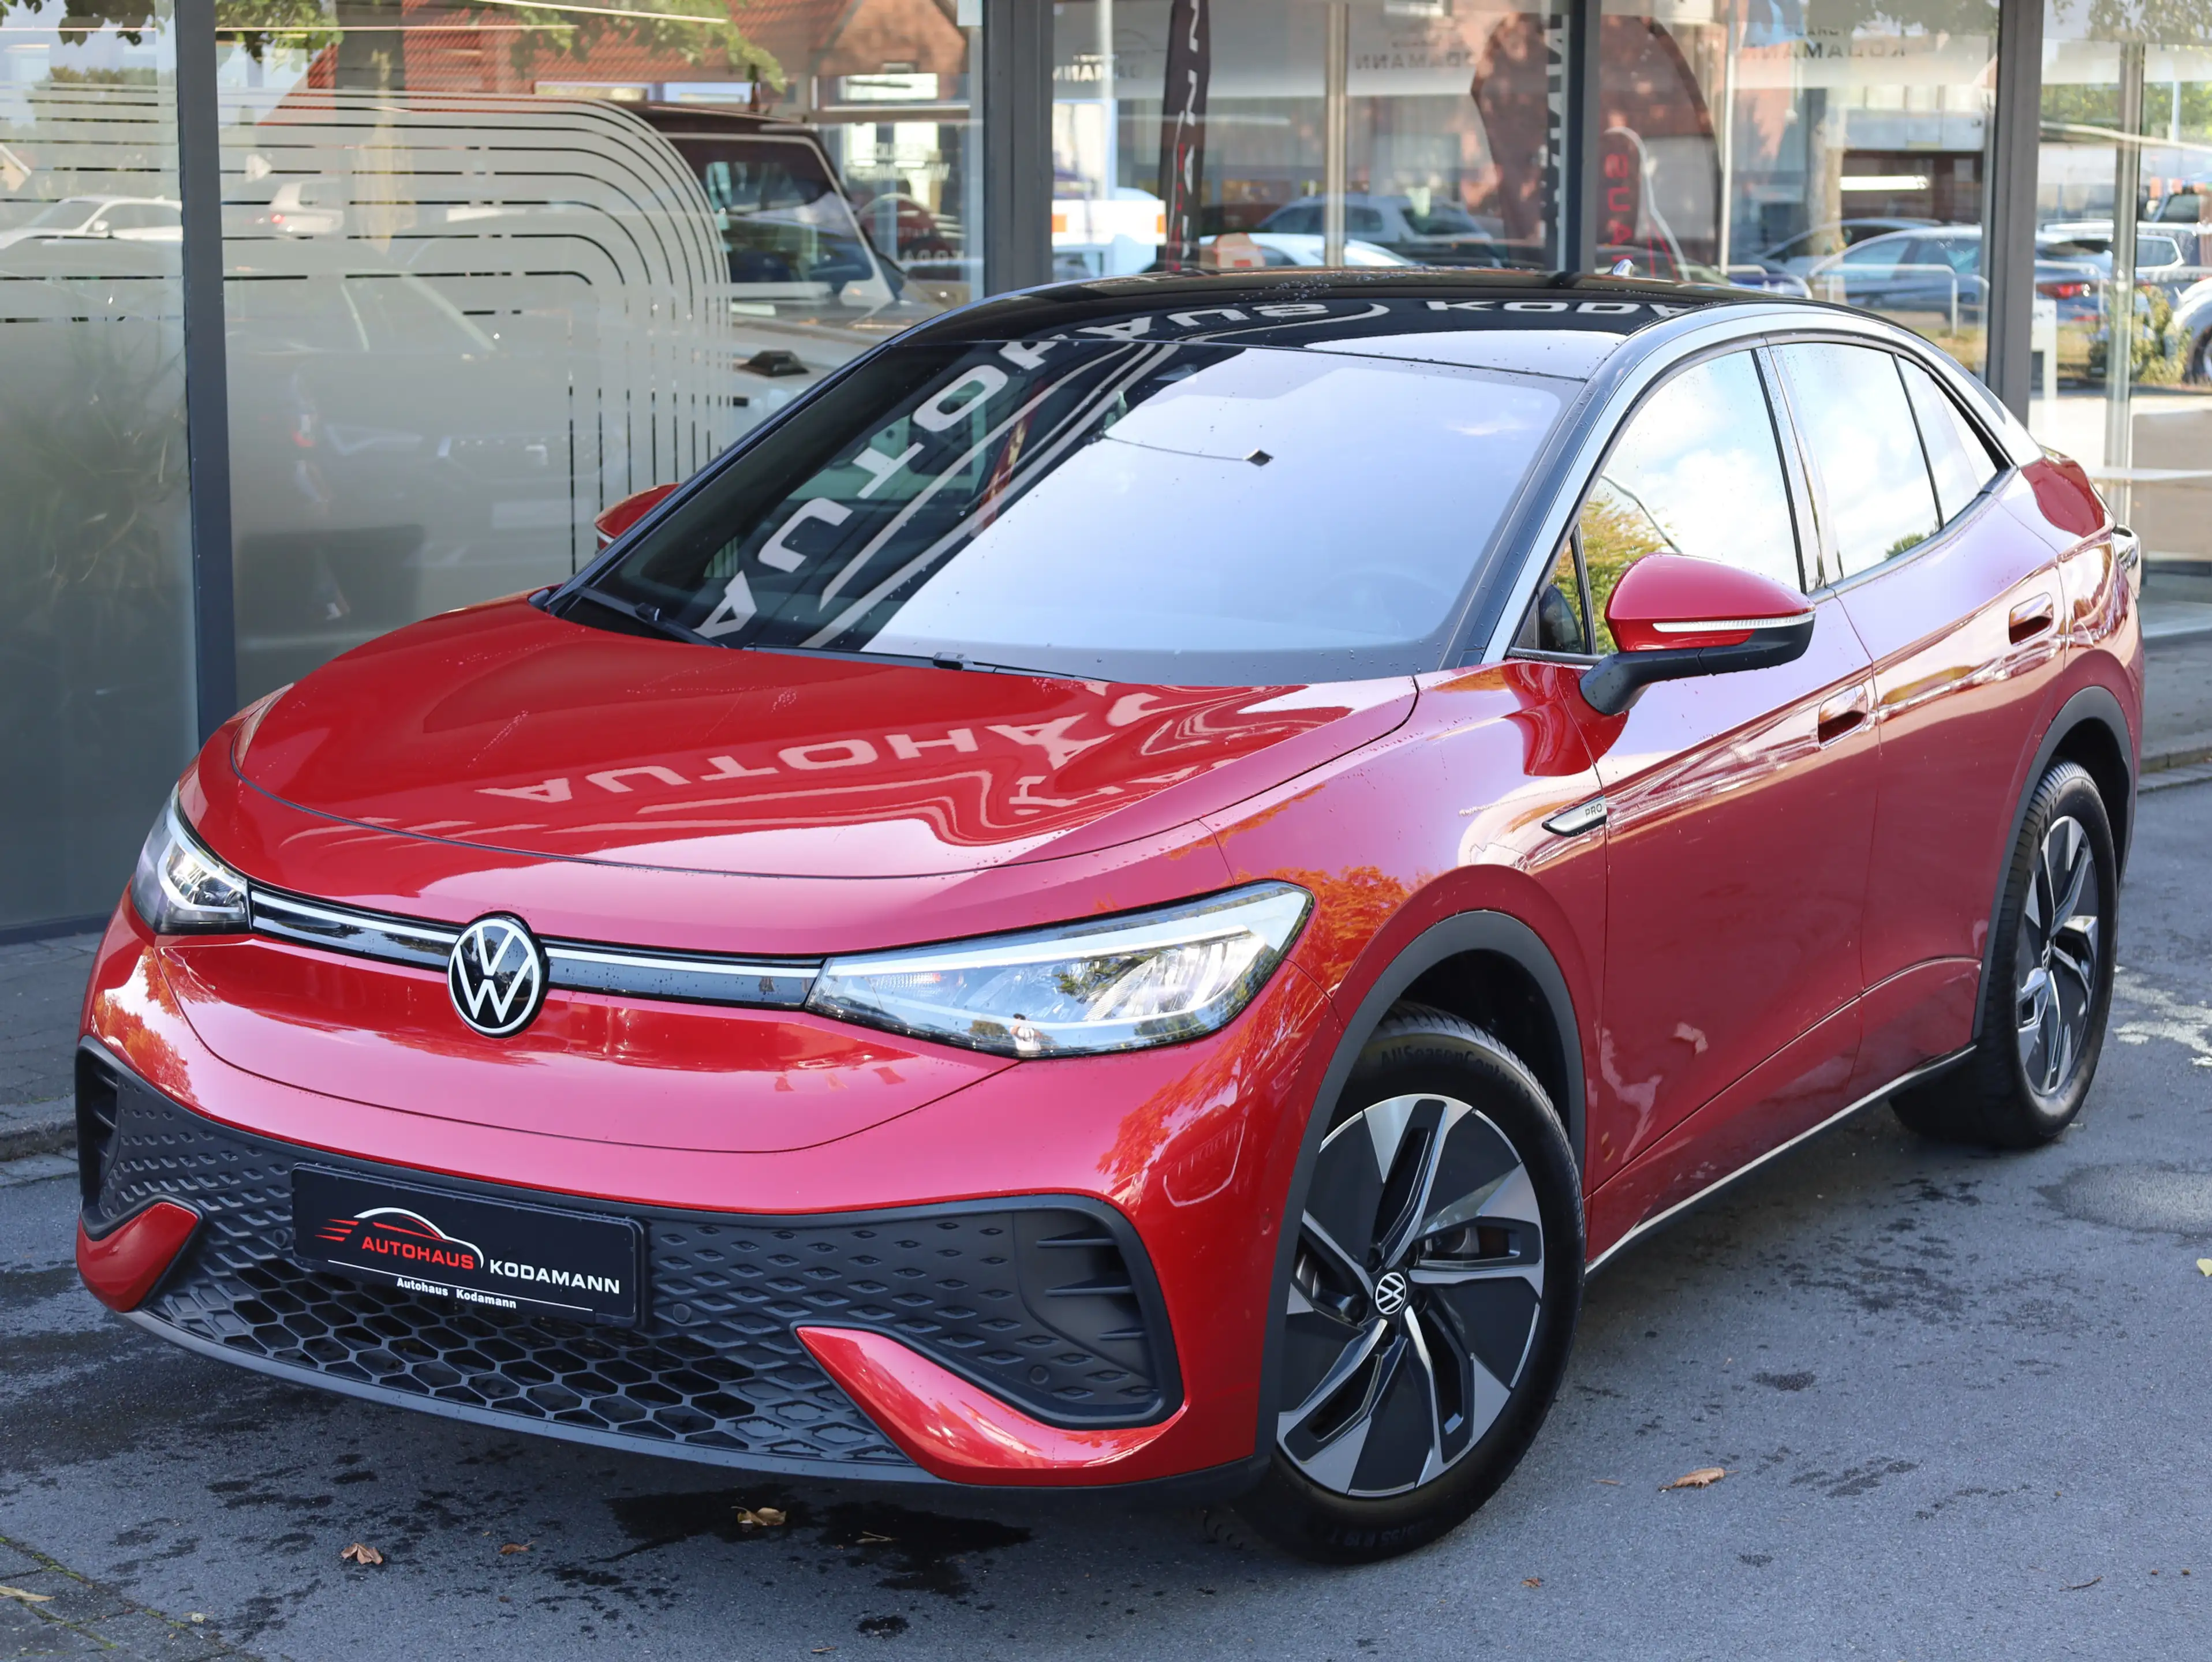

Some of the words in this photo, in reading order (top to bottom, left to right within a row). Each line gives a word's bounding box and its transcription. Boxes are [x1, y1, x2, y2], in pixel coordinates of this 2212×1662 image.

[1585, 803, 1602, 817] PRO
[361, 1236, 474, 1270] AUTOHAUS
[490, 1259, 620, 1294] KODAMANN
[397, 1277, 449, 1297] Autohaus
[456, 1289, 517, 1309] Kodamann
